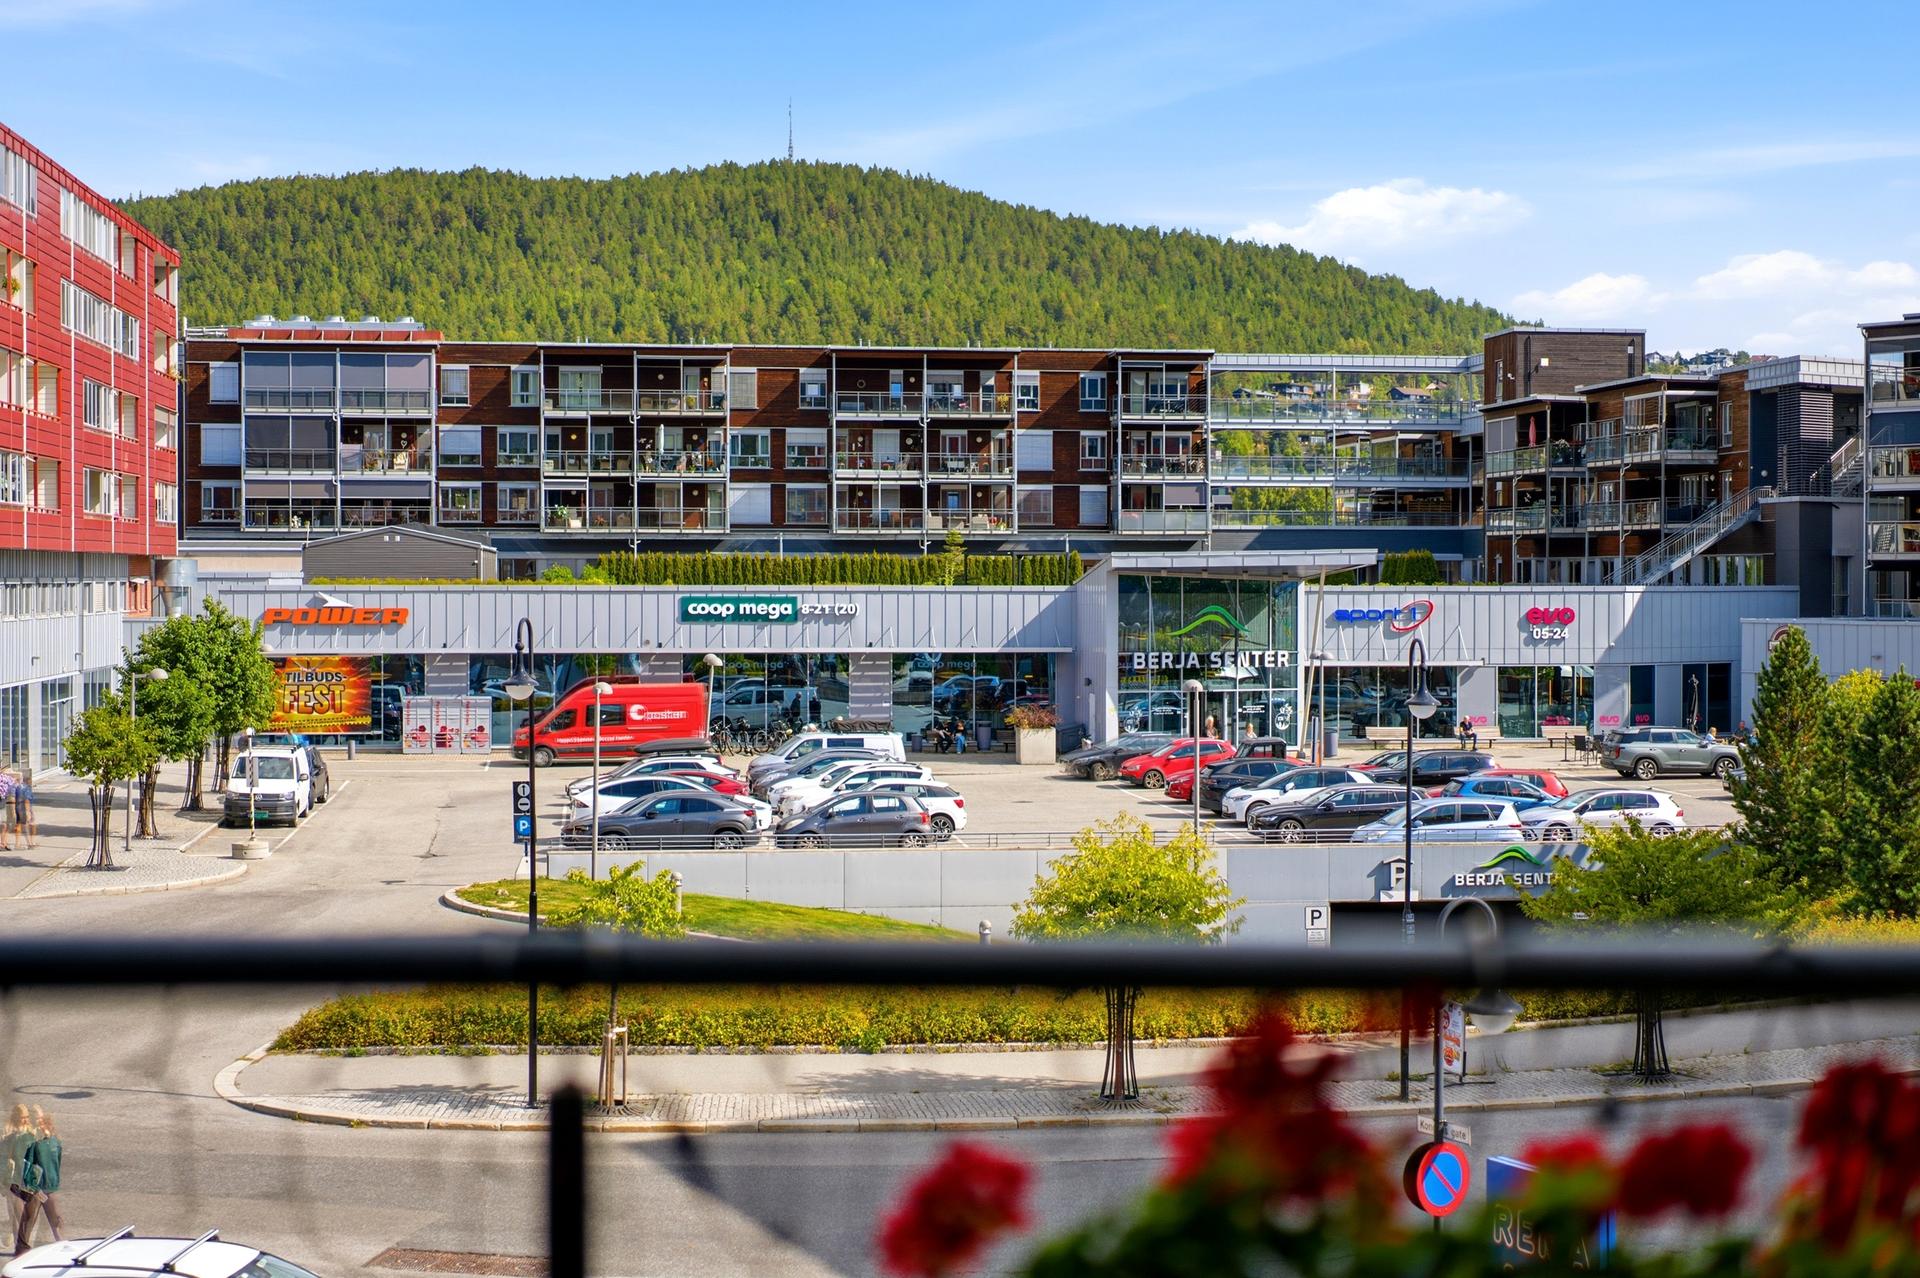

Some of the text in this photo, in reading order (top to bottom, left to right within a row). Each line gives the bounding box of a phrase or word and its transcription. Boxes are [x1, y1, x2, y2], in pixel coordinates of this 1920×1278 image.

[263, 608, 409, 625] POWER
[688, 603, 793, 620] coop mega
[801, 602, 860, 617] 8-21 (20)
[1526, 607, 1576, 625] evo
[1533, 627, 1569, 639] 05-24
[1133, 651, 1289, 669] BERJA SENTER
[285, 671, 348, 682] TILBUDS-
[283, 684, 345, 714] FEST
[519, 820, 529, 832] P
[1455, 872, 1554, 886] BERJA SENT
[1310, 909, 1322, 926] P
